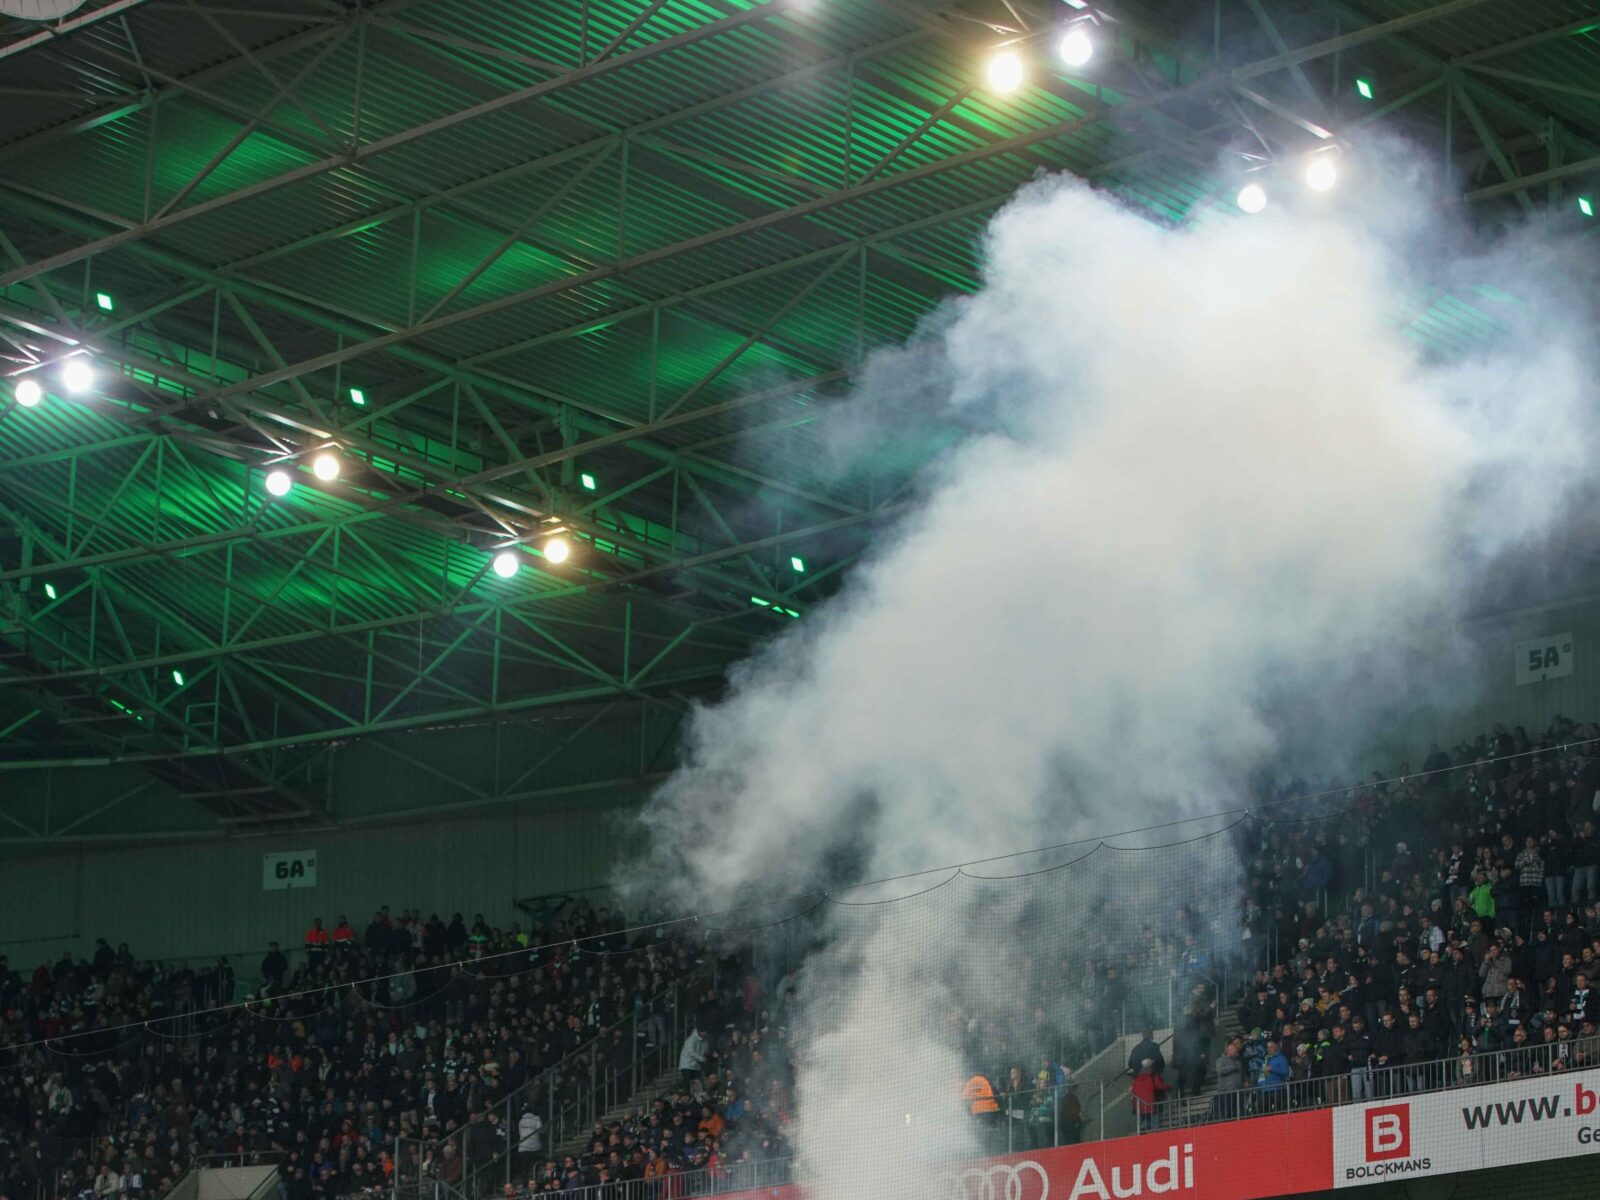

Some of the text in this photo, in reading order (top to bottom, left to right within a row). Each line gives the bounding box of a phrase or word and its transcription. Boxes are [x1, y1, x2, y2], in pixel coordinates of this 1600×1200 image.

[1529, 646, 1560, 672] 5A
[275, 859, 305, 880] 6A
[1462, 1083, 1600, 1130] www.b
[1346, 1158, 1432, 1179] BOLCKMANS
